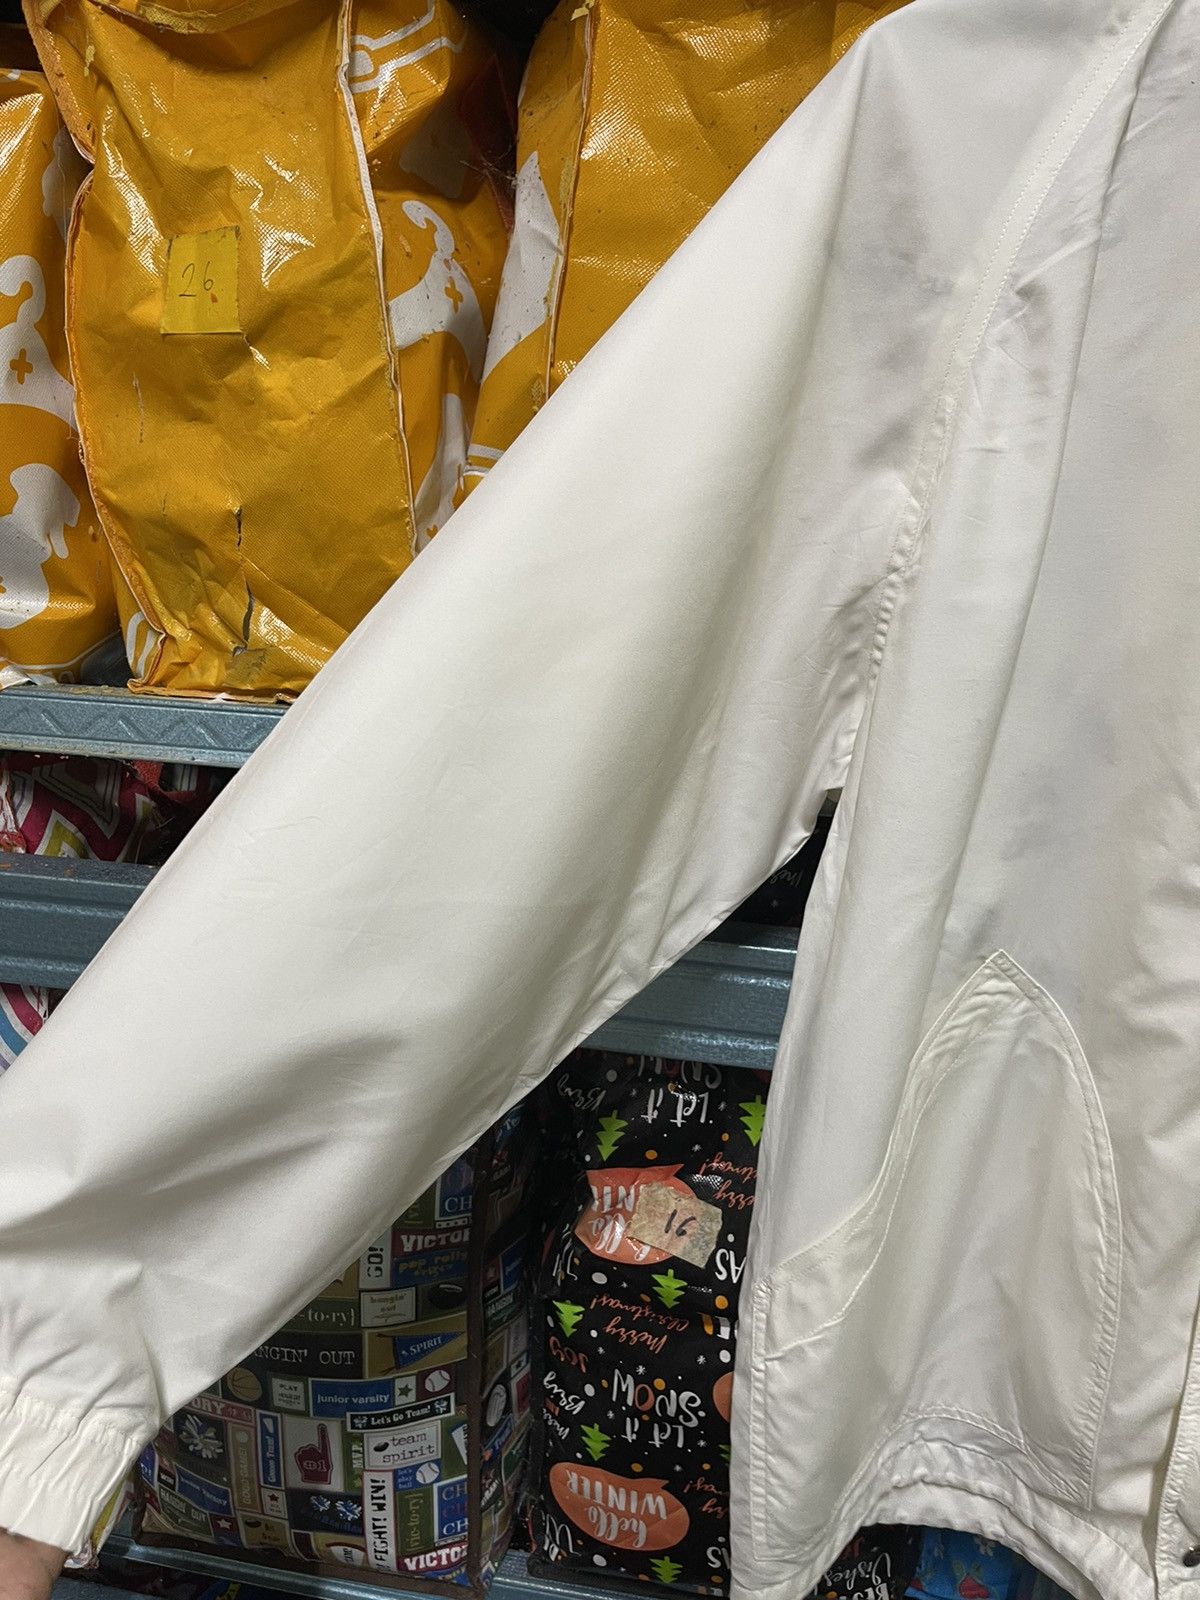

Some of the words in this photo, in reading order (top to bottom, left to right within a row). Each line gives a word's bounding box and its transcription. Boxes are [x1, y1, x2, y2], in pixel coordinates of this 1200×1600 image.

[178, 261, 215, 298] 26
[641, 1088, 664, 1124] it
[670, 1089, 710, 1127] Let
[603, 1316, 668, 1354] Merry
[254, 1346, 307, 1362] NGIN'
[319, 1350, 355, 1364] OUT
[612, 1368, 701, 1428] SNOW
[390, 1431, 427, 1447] team
[620, 1417, 640, 1443] it
[648, 1421, 685, 1448] Let
[382, 1444, 435, 1466] spirit
[370, 1479, 387, 1513] WIN!
[565, 1469, 667, 1520] WINTER
[372, 1517, 389, 1562] FIGHT!
[584, 1505, 648, 1548] hello
